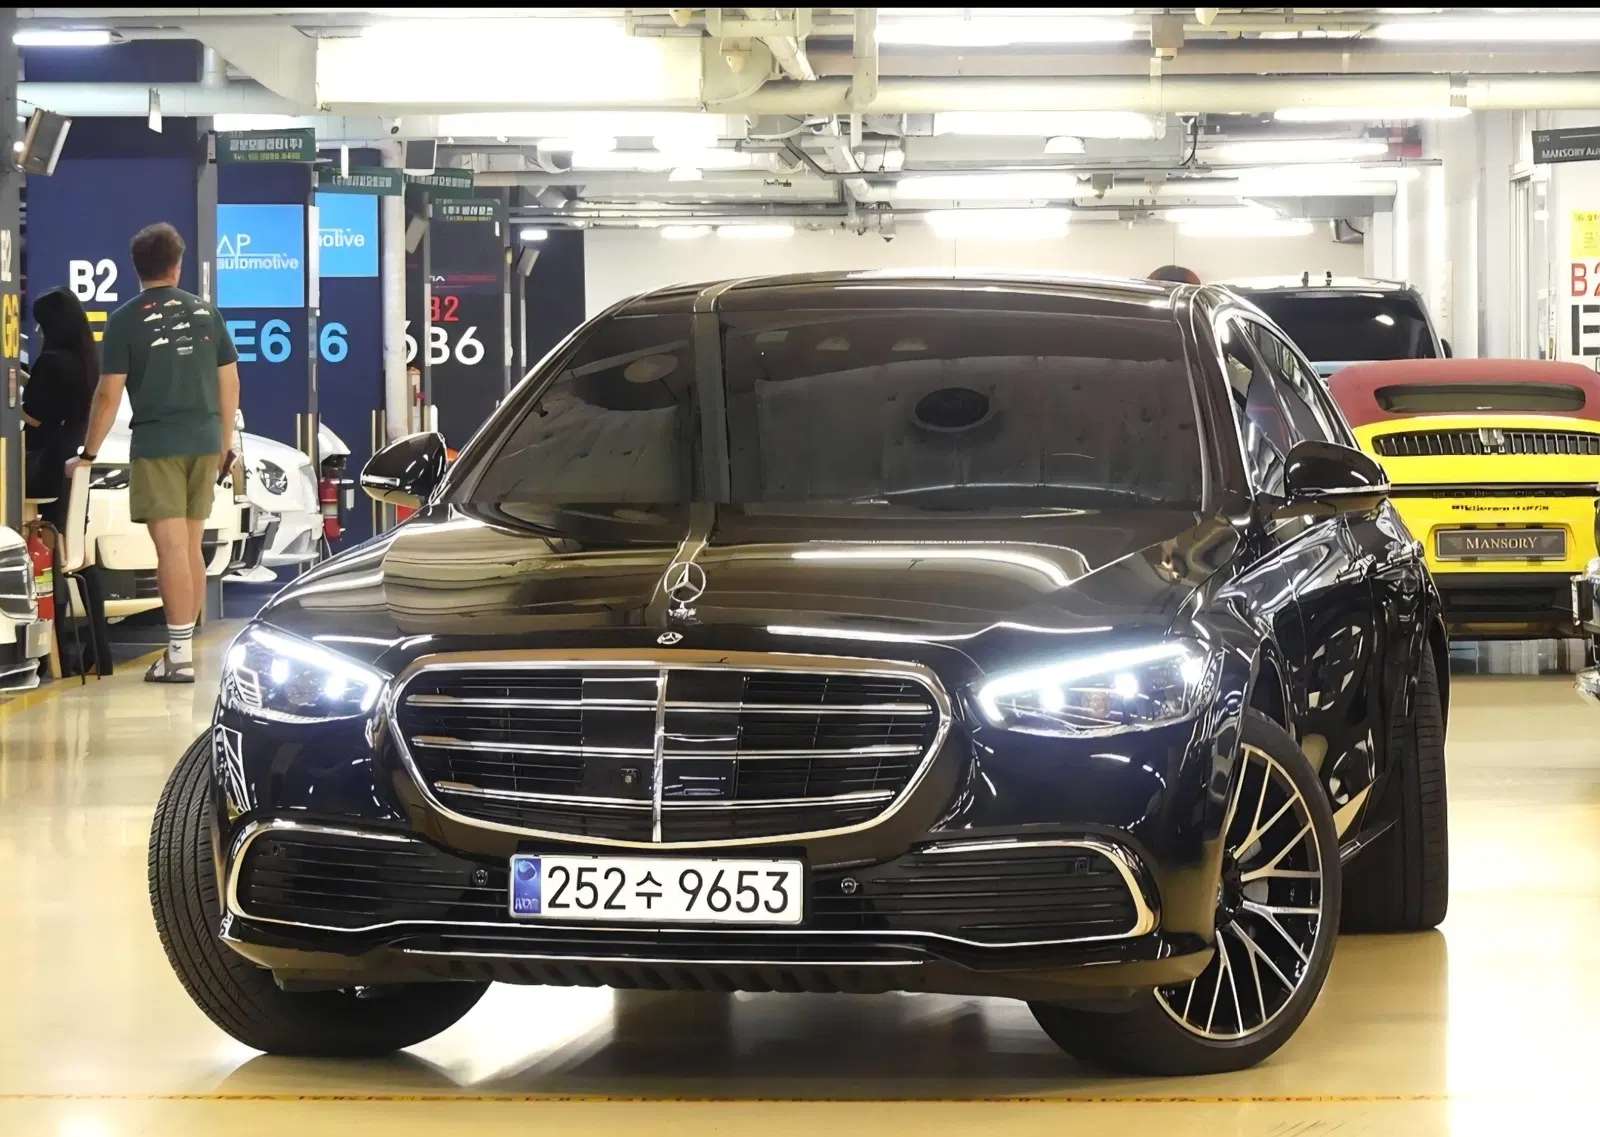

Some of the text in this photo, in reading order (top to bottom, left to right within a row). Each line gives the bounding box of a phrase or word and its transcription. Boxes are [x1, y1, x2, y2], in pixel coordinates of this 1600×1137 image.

[69, 258, 118, 302] B2
[226, 318, 292, 363] E6
[320, 322, 348, 363] 6
[430, 325, 485, 366] B6
[1466, 537, 1538, 549] MANSORY
[547, 865, 789, 914] 252수 9653
